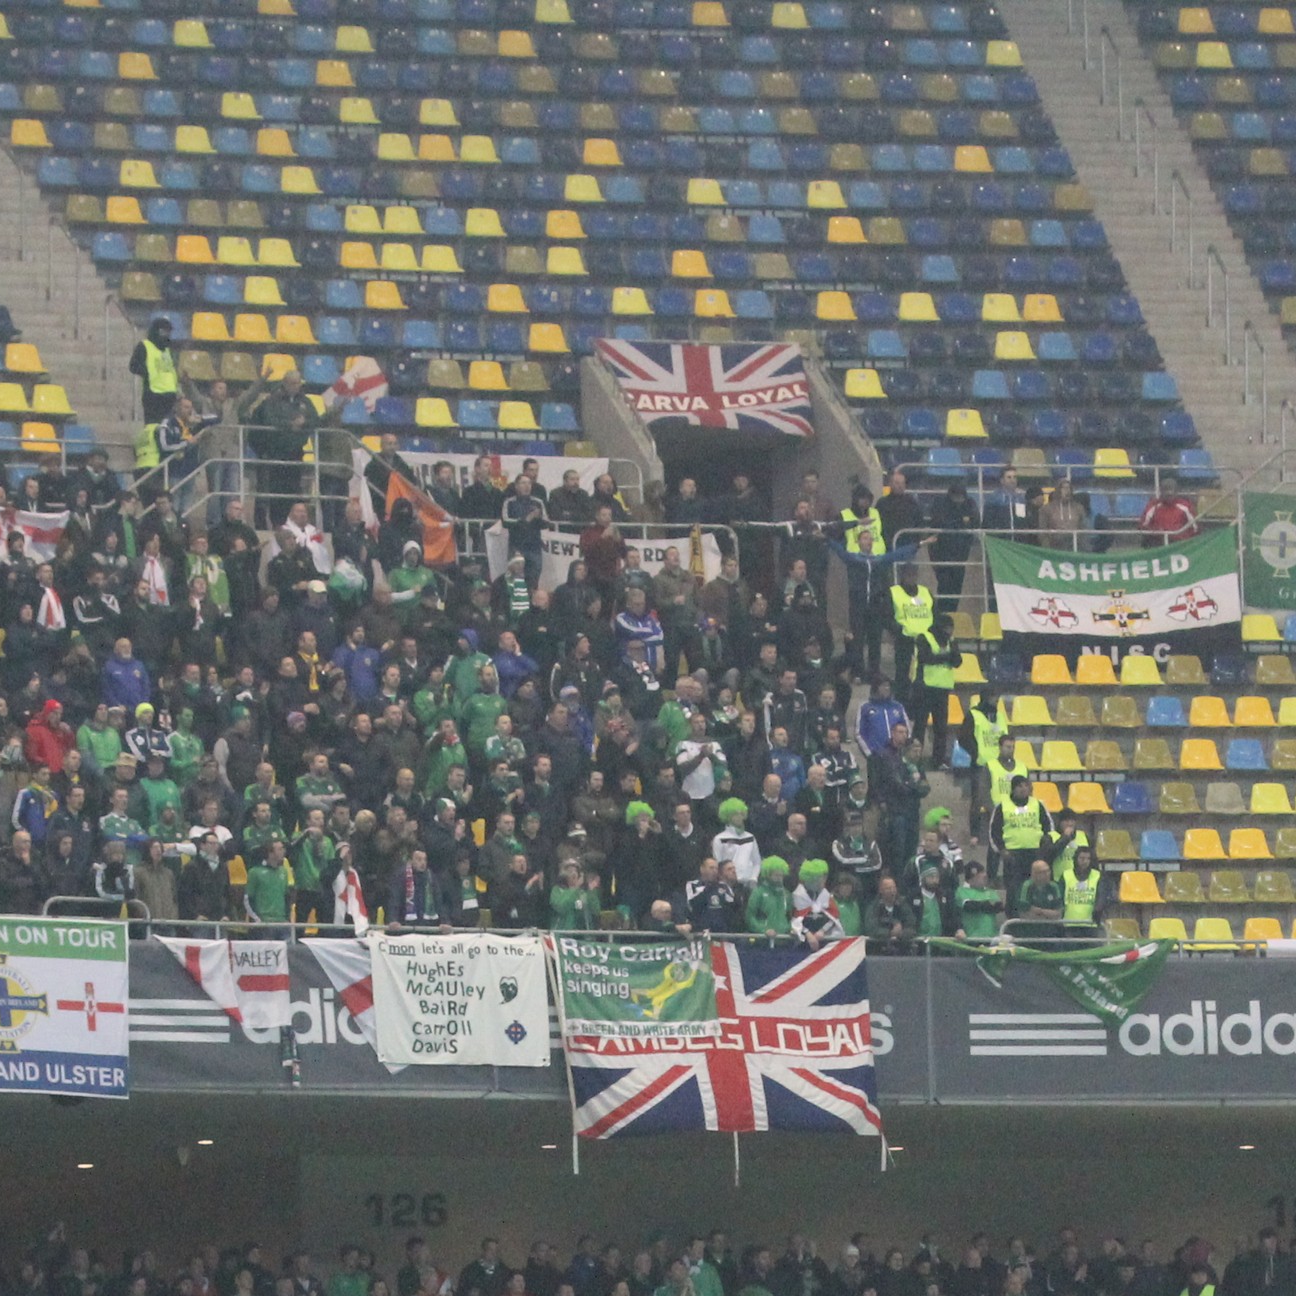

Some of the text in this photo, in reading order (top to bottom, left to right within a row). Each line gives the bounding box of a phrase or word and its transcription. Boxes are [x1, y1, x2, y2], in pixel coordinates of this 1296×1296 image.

[721, 383, 809, 408] LOYAL
[1037, 554, 1190, 582] ASHFIELD
[15, 925, 48, 945] ON
[55, 927, 116, 949] TOUR
[234, 949, 282, 967] VALLEY
[422, 943, 445, 955] let's
[451, 944, 464, 954] all
[468, 946, 480, 959] go
[487, 945, 498, 955] to
[560, 938, 611, 962] Roy
[564, 960, 629, 978] keeps us
[566, 978, 630, 998] singing
[581, 1023, 706, 1036] GREEN AND WHITE ARMY
[749, 1020, 870, 1055] LOYAL
[46, 1064, 126, 1088] ULSTER
[367, 1192, 449, 1227] 126
